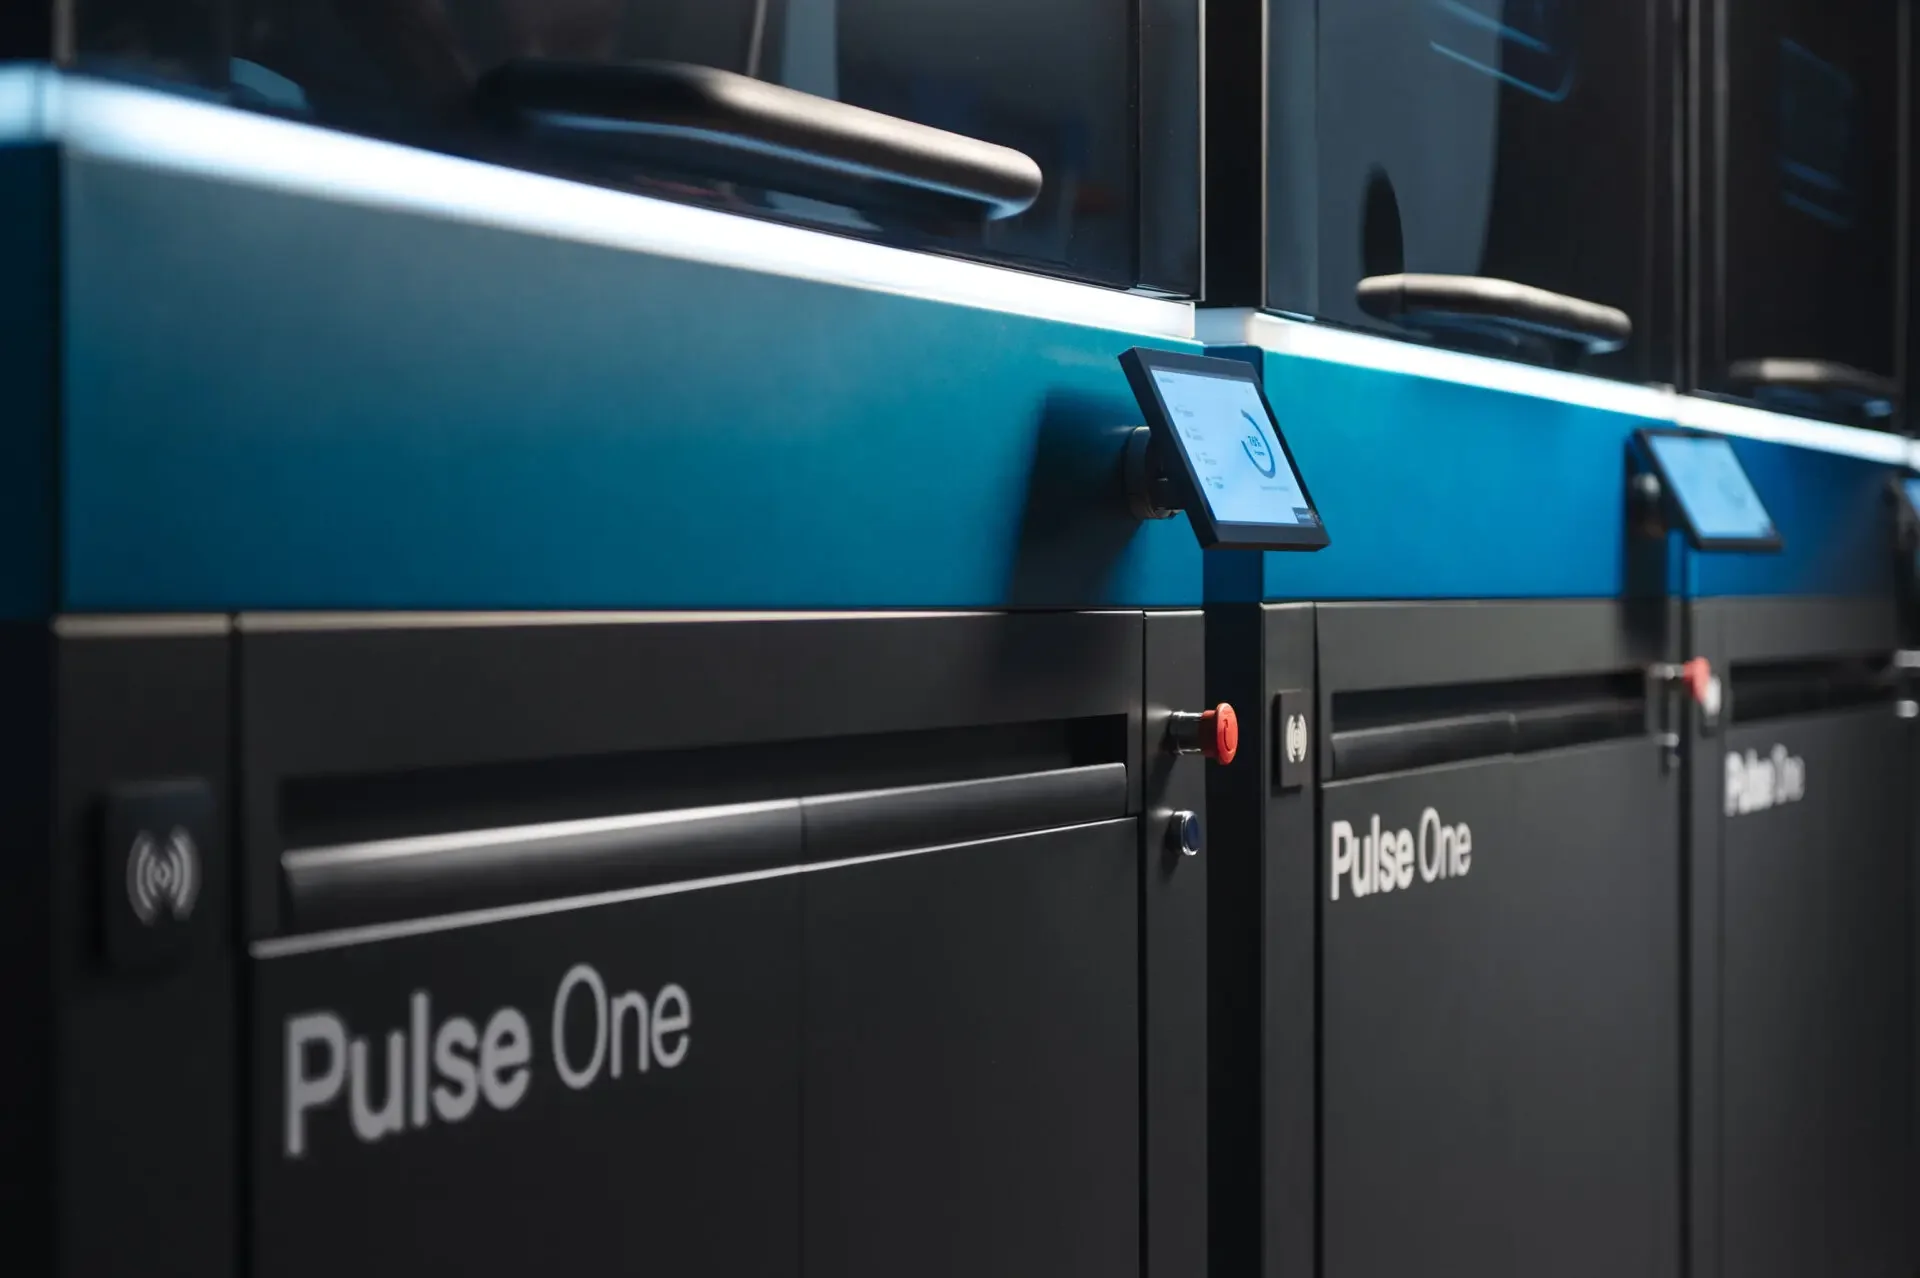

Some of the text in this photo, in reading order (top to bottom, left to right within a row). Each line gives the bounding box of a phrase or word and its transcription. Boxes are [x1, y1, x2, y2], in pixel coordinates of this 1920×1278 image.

[1331, 806, 1472, 901] Pulse One
[284, 964, 691, 1158] Pulse One
